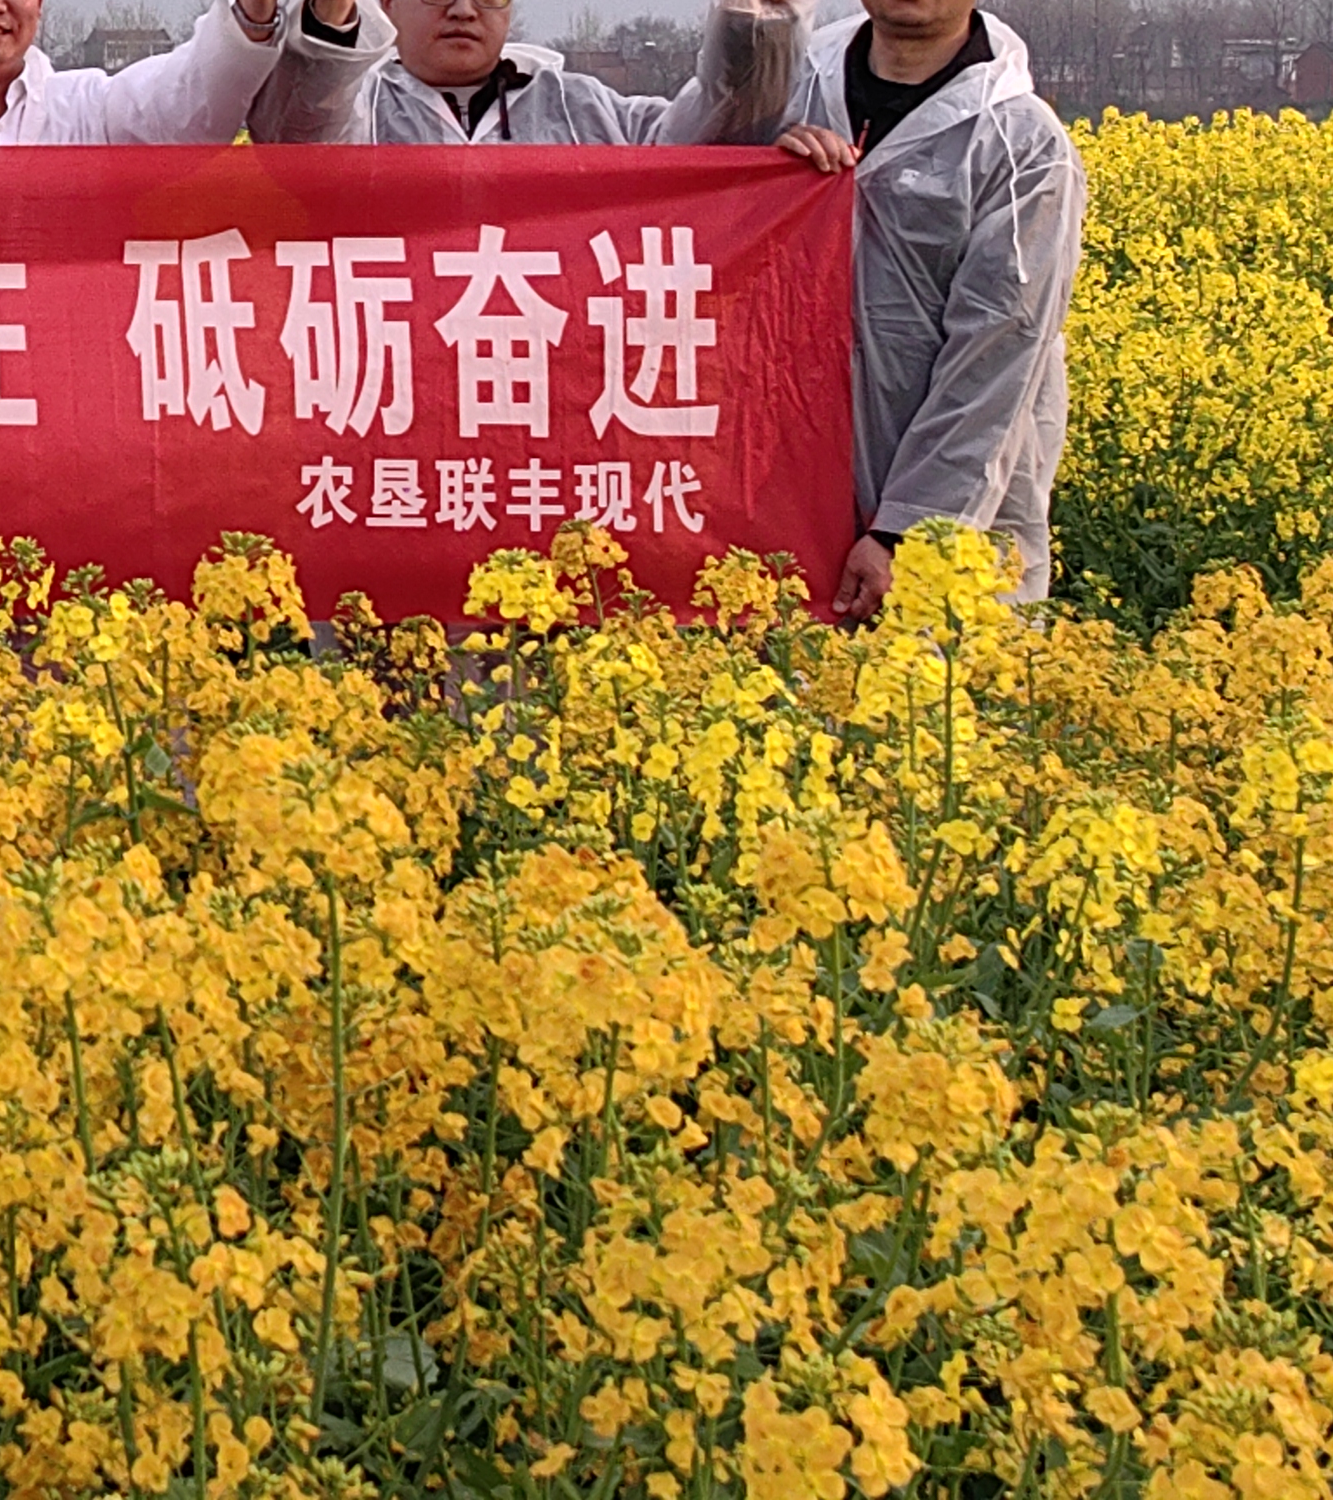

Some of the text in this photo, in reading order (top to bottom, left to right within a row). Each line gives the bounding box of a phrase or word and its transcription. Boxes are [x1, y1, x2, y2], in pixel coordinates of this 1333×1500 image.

[123, 223, 720, 440] 砥砺奋进
[295, 455, 705, 532] 农垦联丰现代
